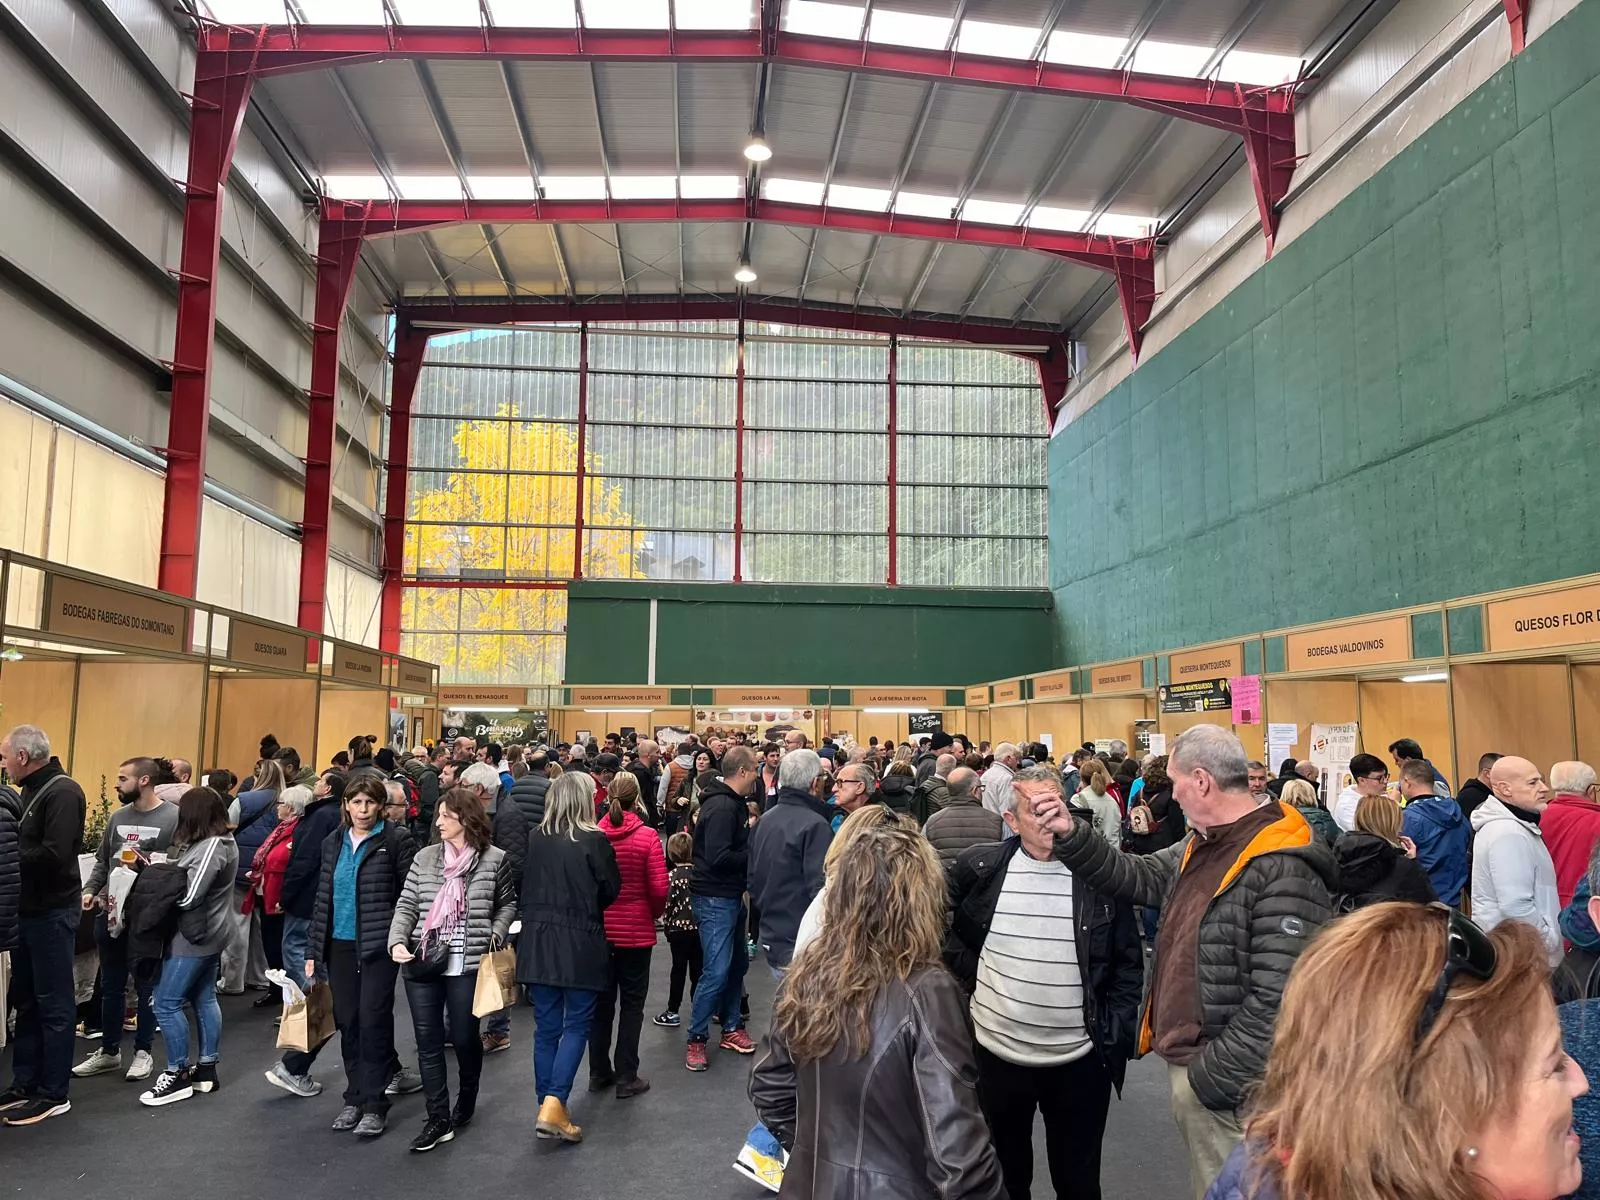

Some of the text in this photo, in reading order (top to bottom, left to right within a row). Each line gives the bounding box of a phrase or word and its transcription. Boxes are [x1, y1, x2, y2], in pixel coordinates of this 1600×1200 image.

[62, 603, 175, 636] BODEGAS FABREGAS DO SOMONTANO
[1514, 615, 1560, 632] QUESOS
[1562, 610, 1594, 627] FLOR
[254, 642, 288, 657] QUESOS GUARA
[1307, 638, 1384, 657] BODEGAS VALDOVINOS
[1180, 659, 1231, 674] QUESERIA MONTEQUESOS
